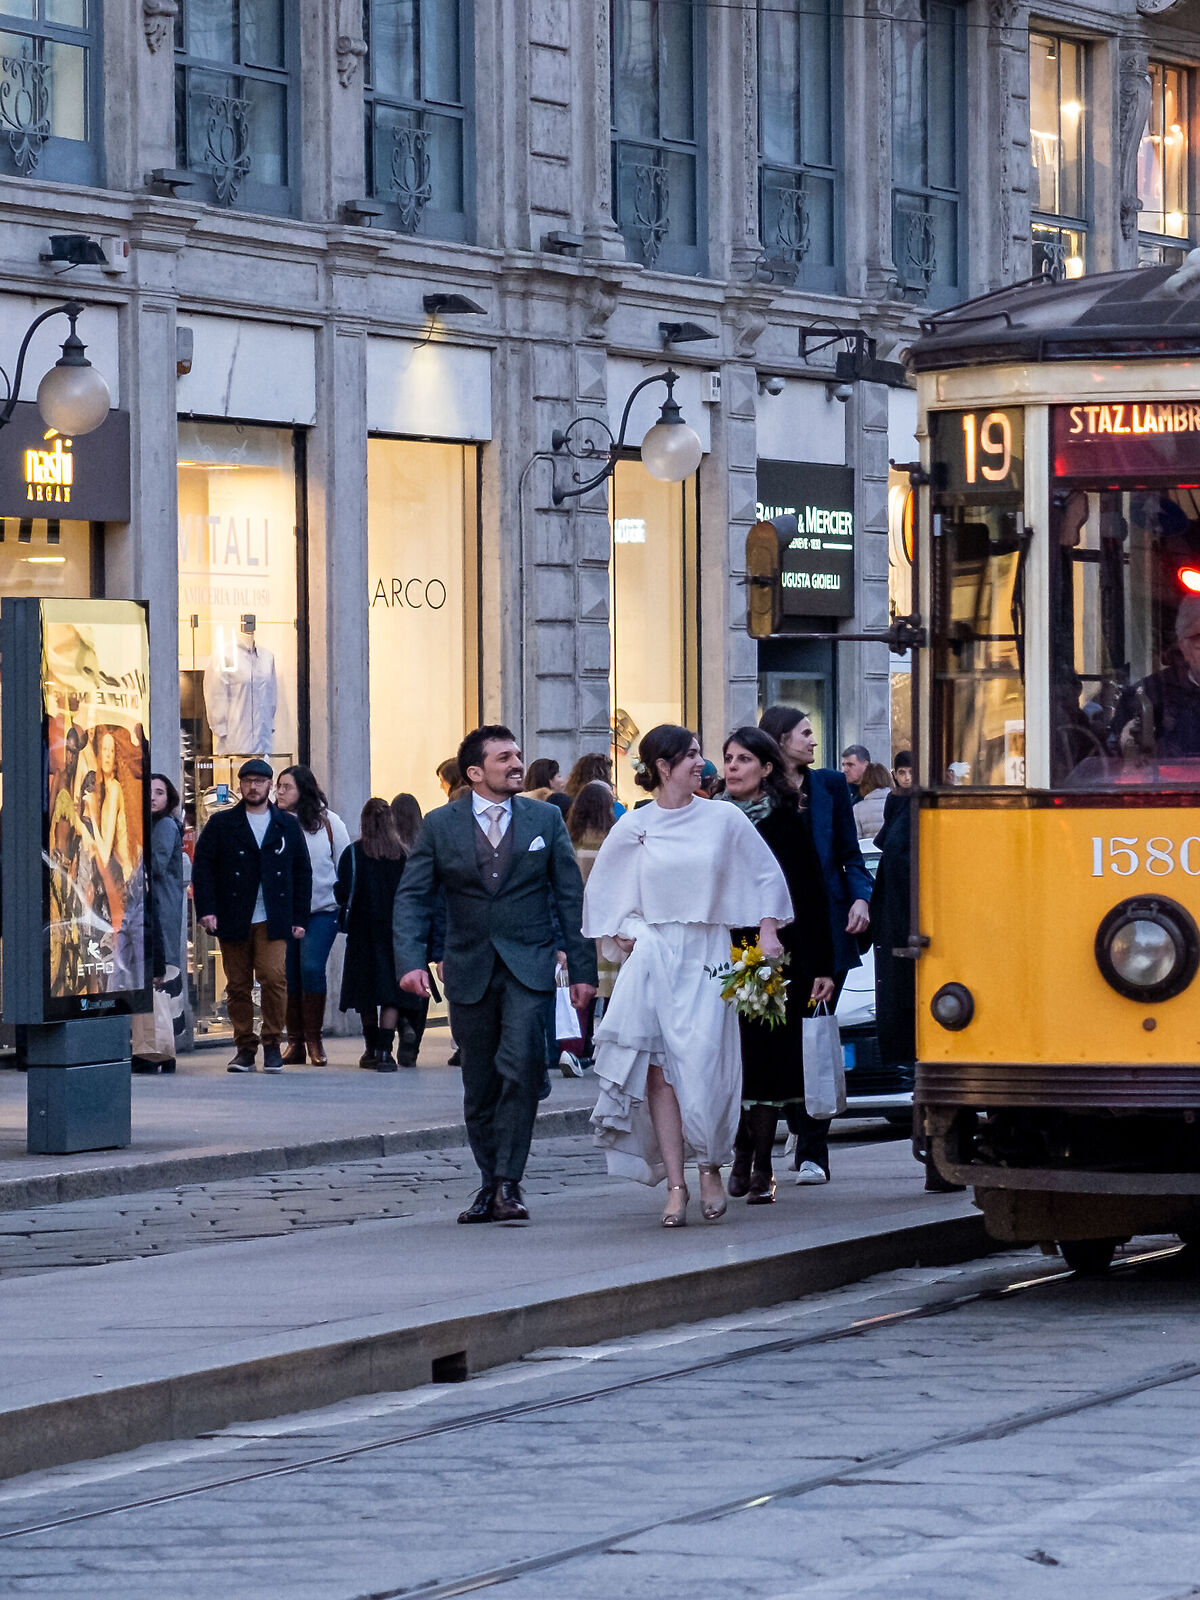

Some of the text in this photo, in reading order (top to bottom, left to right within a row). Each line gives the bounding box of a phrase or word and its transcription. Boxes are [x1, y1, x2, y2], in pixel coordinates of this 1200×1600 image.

[962, 412, 1012, 484] 19
[26, 484, 71, 503] ARGAN
[797, 513, 805, 534] &
[805, 505, 853, 536] MERCIER
[178, 513, 269, 567] VITALI
[179, 584, 231, 607] AMICERIA
[368, 577, 447, 610] ARCO
[781, 571, 841, 590] UGUSTA GIOIELLI
